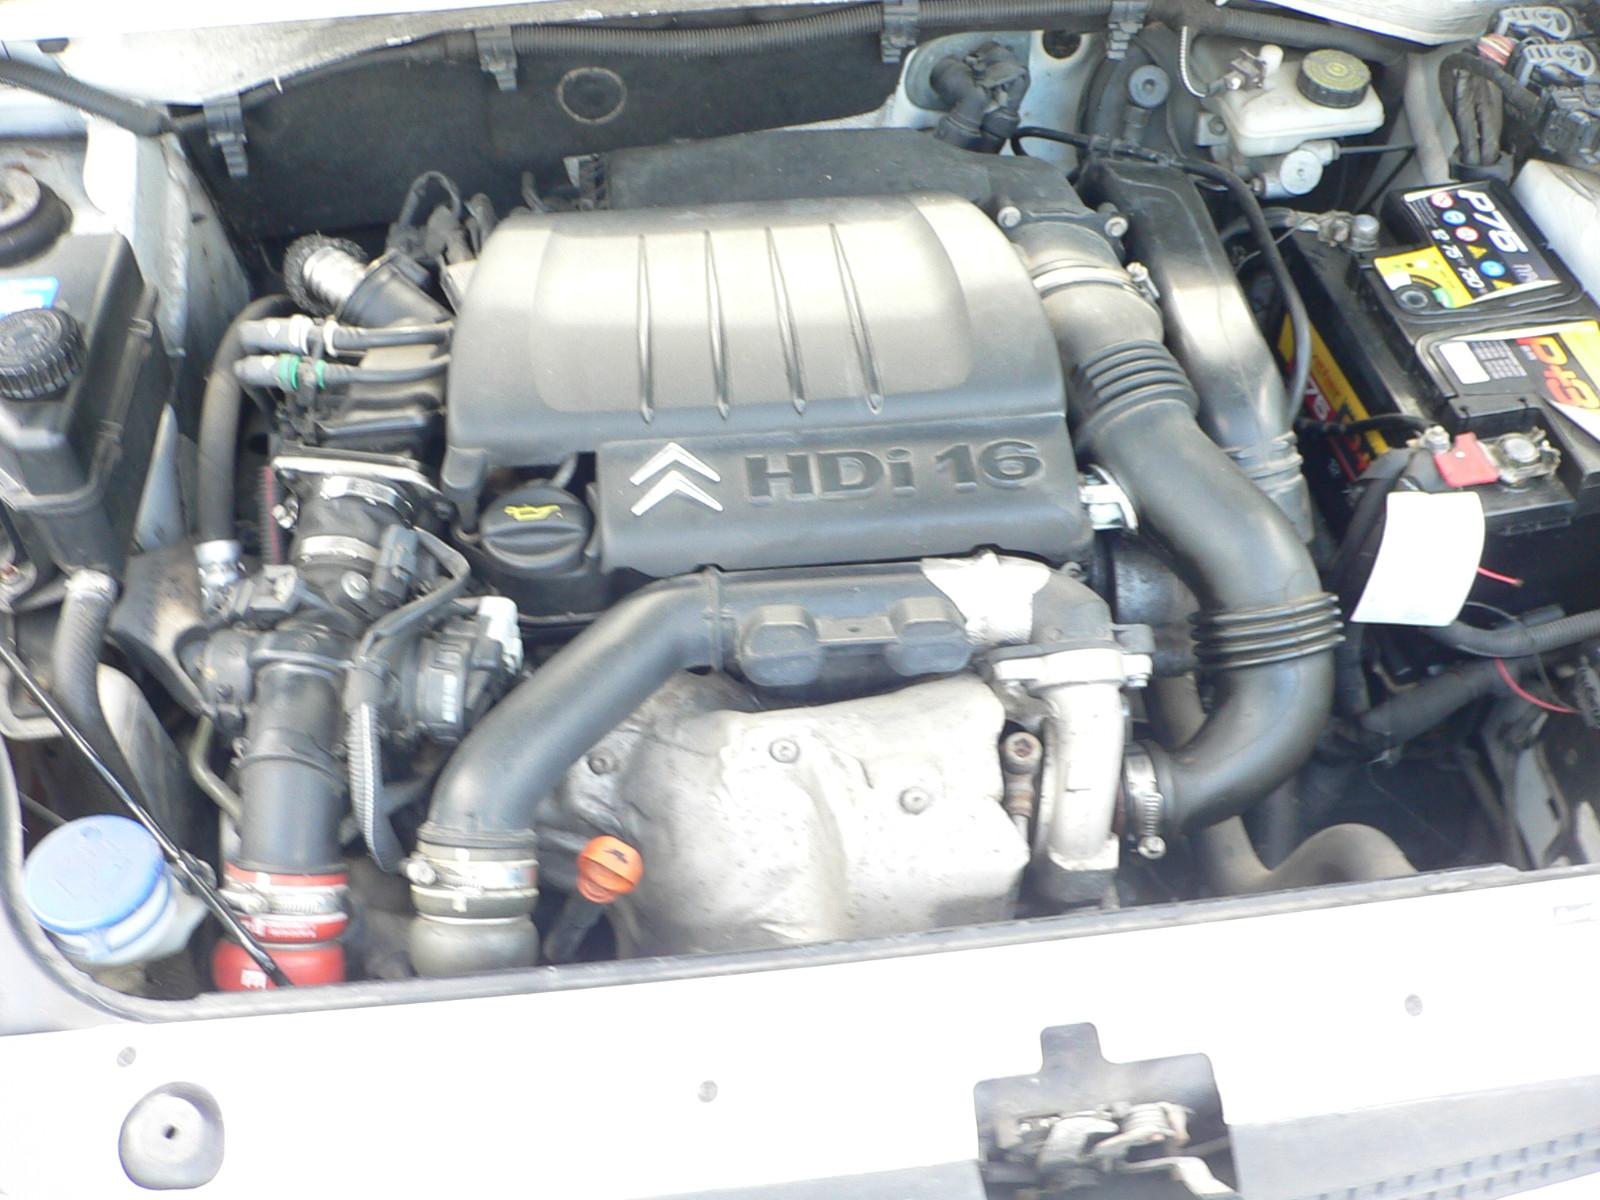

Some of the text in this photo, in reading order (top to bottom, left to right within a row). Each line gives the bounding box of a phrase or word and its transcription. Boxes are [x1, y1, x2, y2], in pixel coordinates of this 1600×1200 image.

[1458, 266, 1485, 289] 750
[744, 440, 1045, 504] HDi 16
